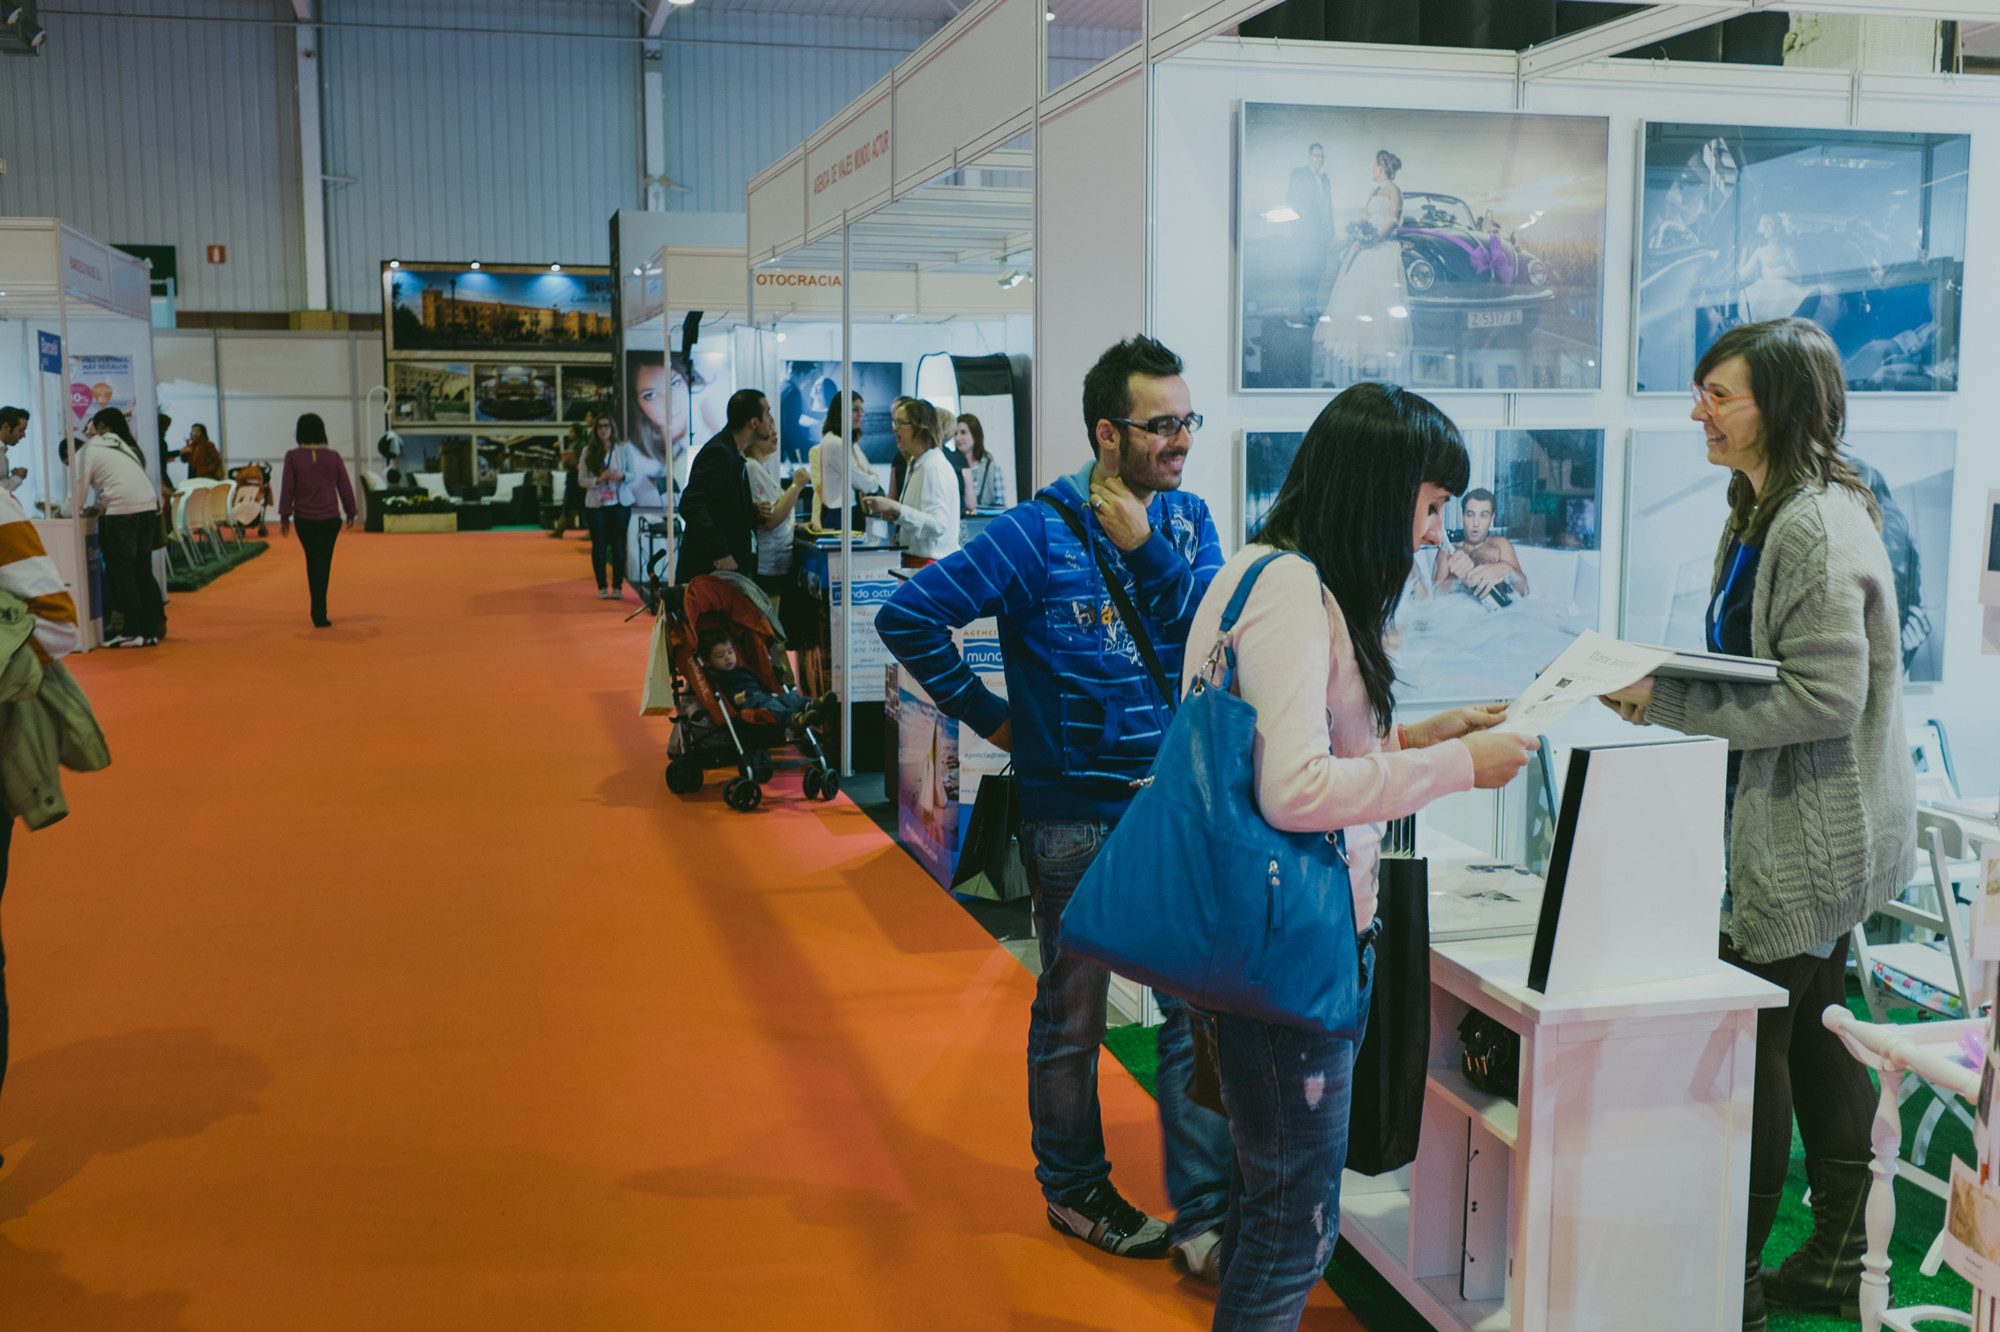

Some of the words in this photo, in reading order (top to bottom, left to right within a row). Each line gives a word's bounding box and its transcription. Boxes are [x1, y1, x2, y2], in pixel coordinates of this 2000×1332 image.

[831, 163, 838, 185] DE
[755, 274, 842, 287] OTOCRACIA
[834, 588, 870, 599] mndo
